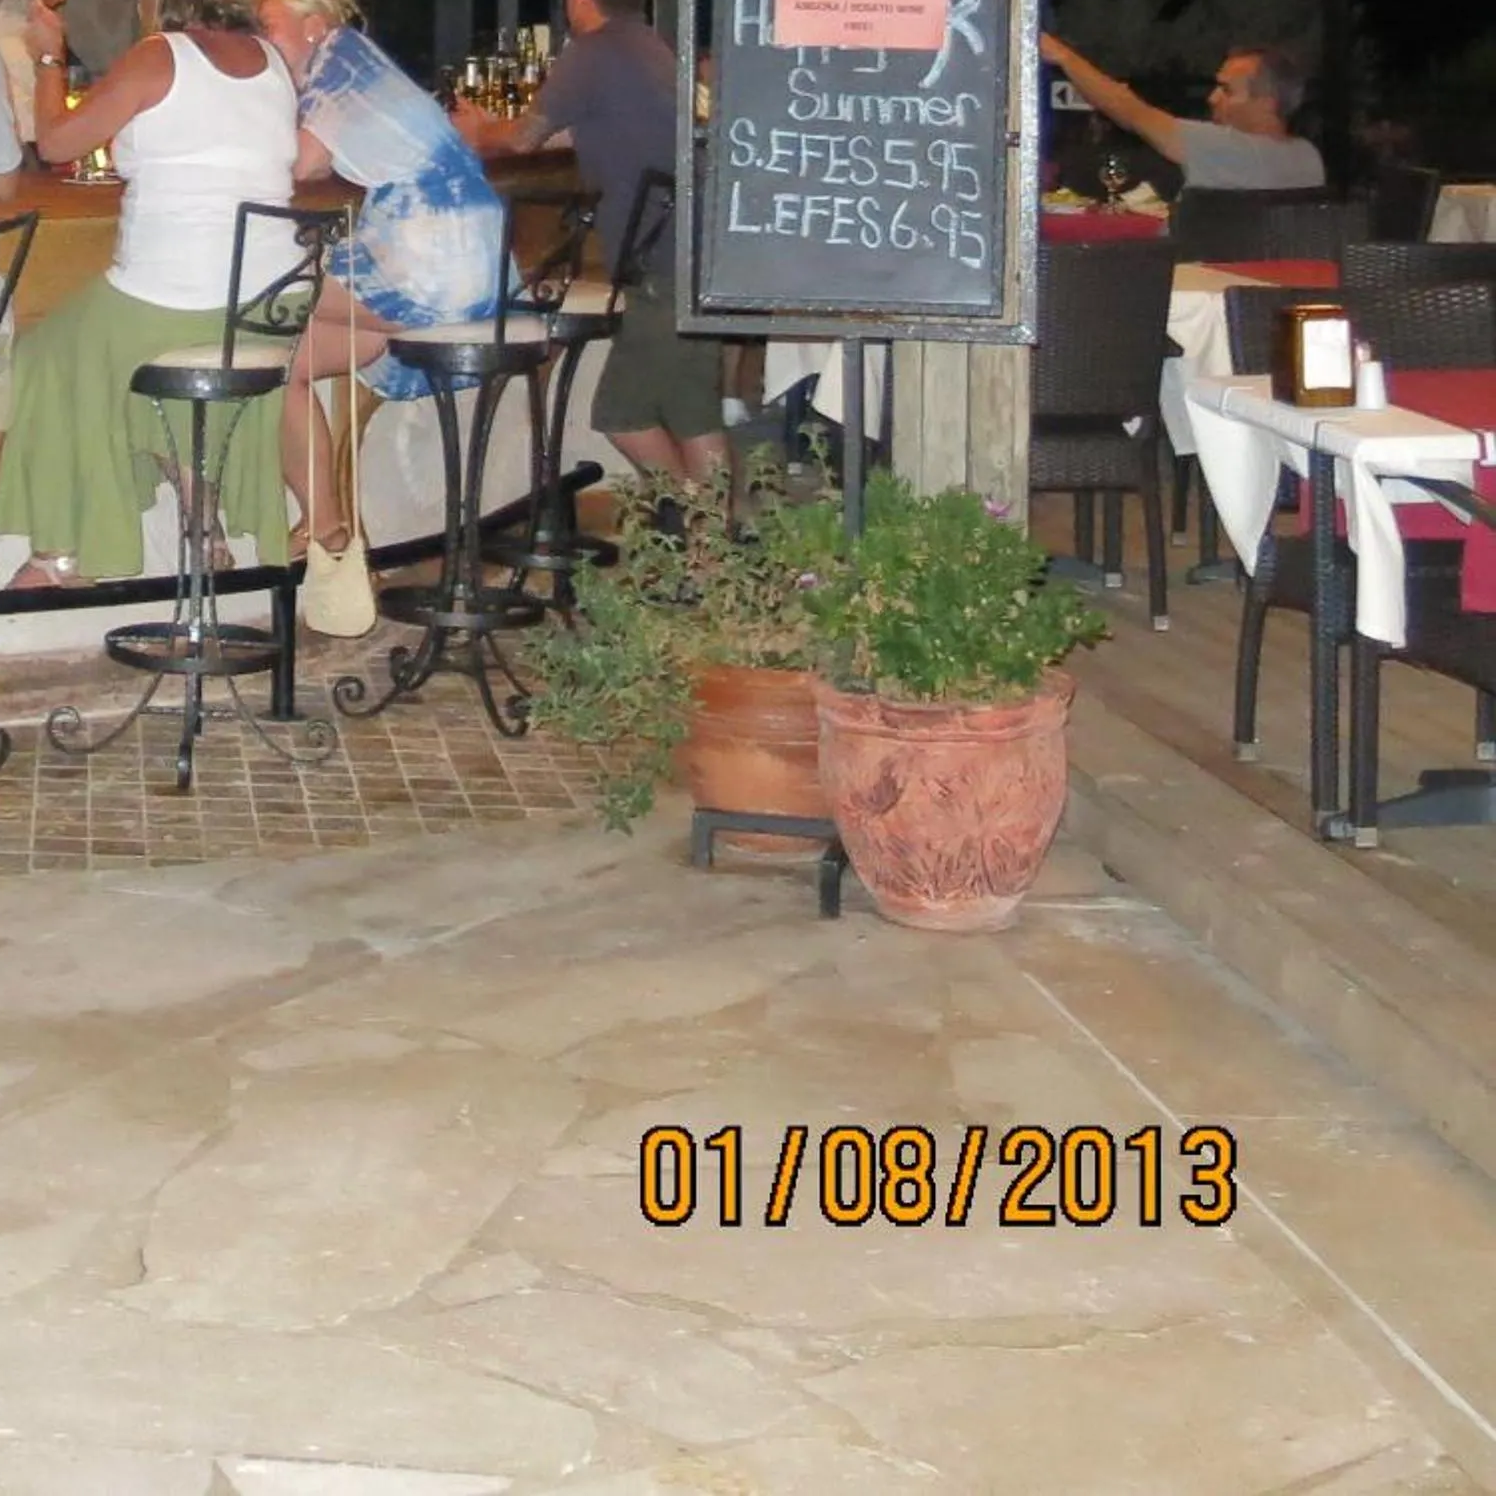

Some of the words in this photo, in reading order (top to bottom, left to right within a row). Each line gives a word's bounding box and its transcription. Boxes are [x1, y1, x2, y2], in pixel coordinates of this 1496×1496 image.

[787, 67, 982, 128] Summer
[729, 116, 879, 187] S.EFES
[882, 138, 982, 202] 5.95
[727, 180, 882, 249] L.EFES
[889, 199, 986, 269] 6.95
